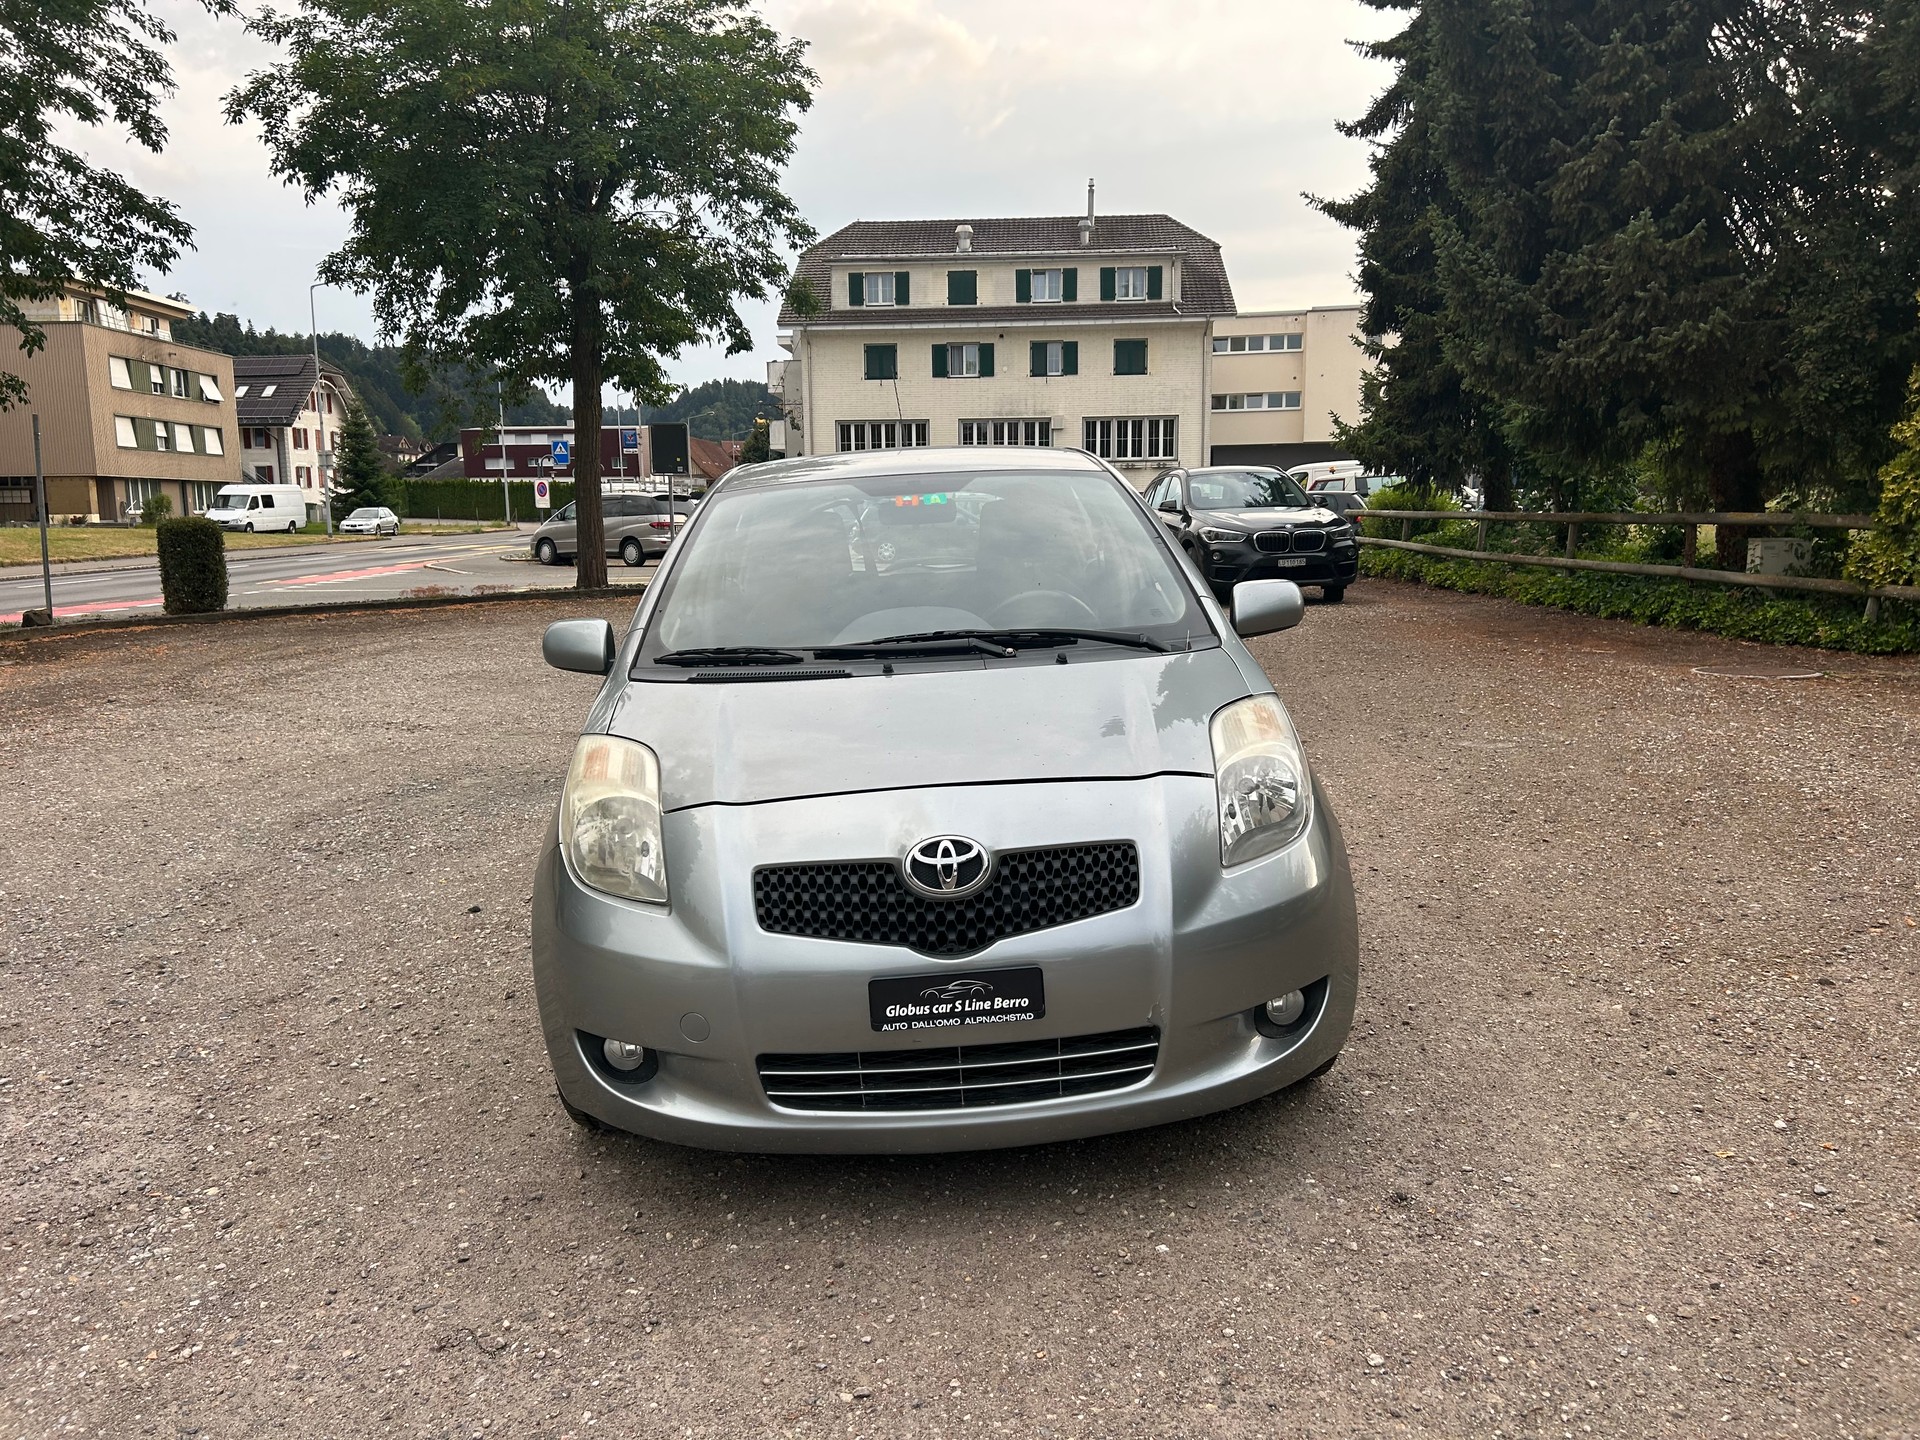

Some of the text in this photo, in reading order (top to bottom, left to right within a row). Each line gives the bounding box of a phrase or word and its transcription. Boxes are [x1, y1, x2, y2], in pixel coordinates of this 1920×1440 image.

[886, 997, 1029, 1017] Globus car S Line Berro
[882, 1013, 1034, 1031] AUTO DALL'OMO ALPNACHSTAD
